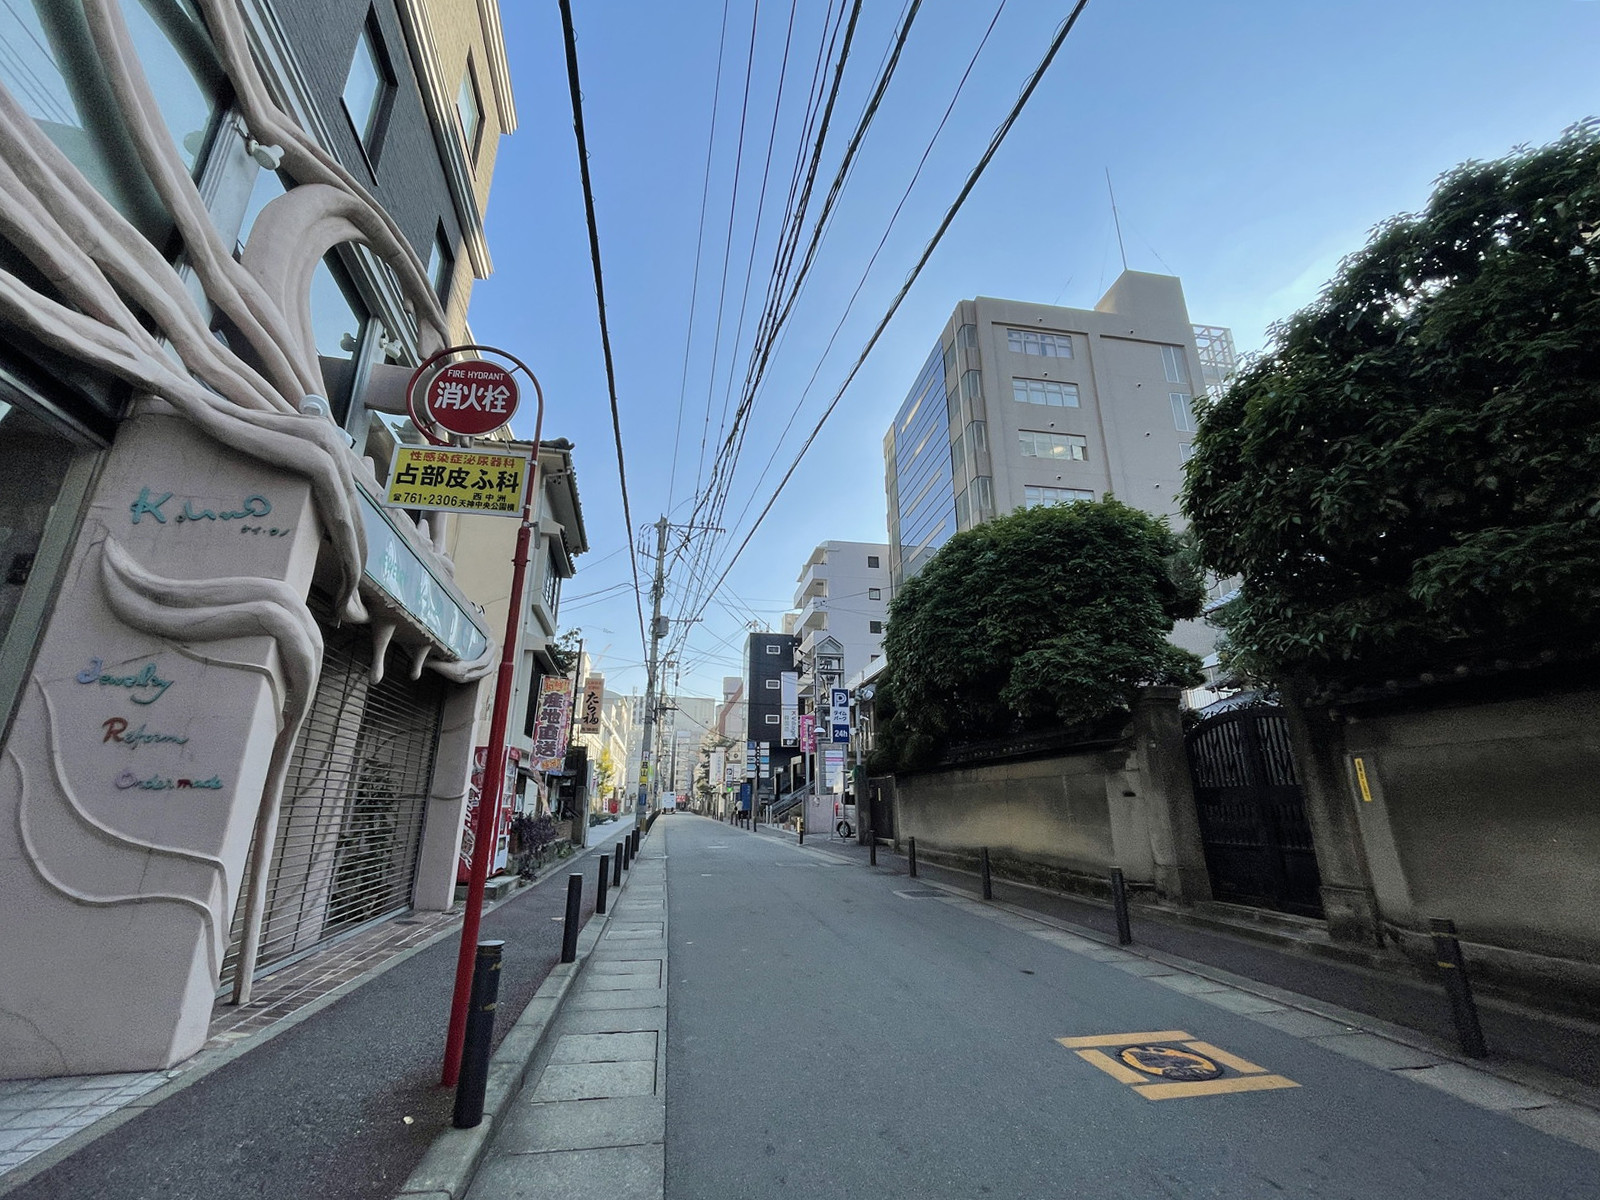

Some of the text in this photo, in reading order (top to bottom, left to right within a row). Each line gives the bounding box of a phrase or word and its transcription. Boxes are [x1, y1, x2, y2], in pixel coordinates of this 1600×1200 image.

[447, 369, 505, 381] FIRE HYDRANT
[434, 381, 511, 414] 消火栓
[410, 450, 516, 469] 性感染症泌尿器科
[395, 463, 519, 493] 占部皮ふ科
[473, 492, 506, 503] 西中洲
[76, 656, 174, 705] Jewelry
[834, 691, 847, 708] P
[102, 717, 189, 750] Reform
[535, 692, 563, 757] 産地直送
[834, 729, 848, 738] 24h
